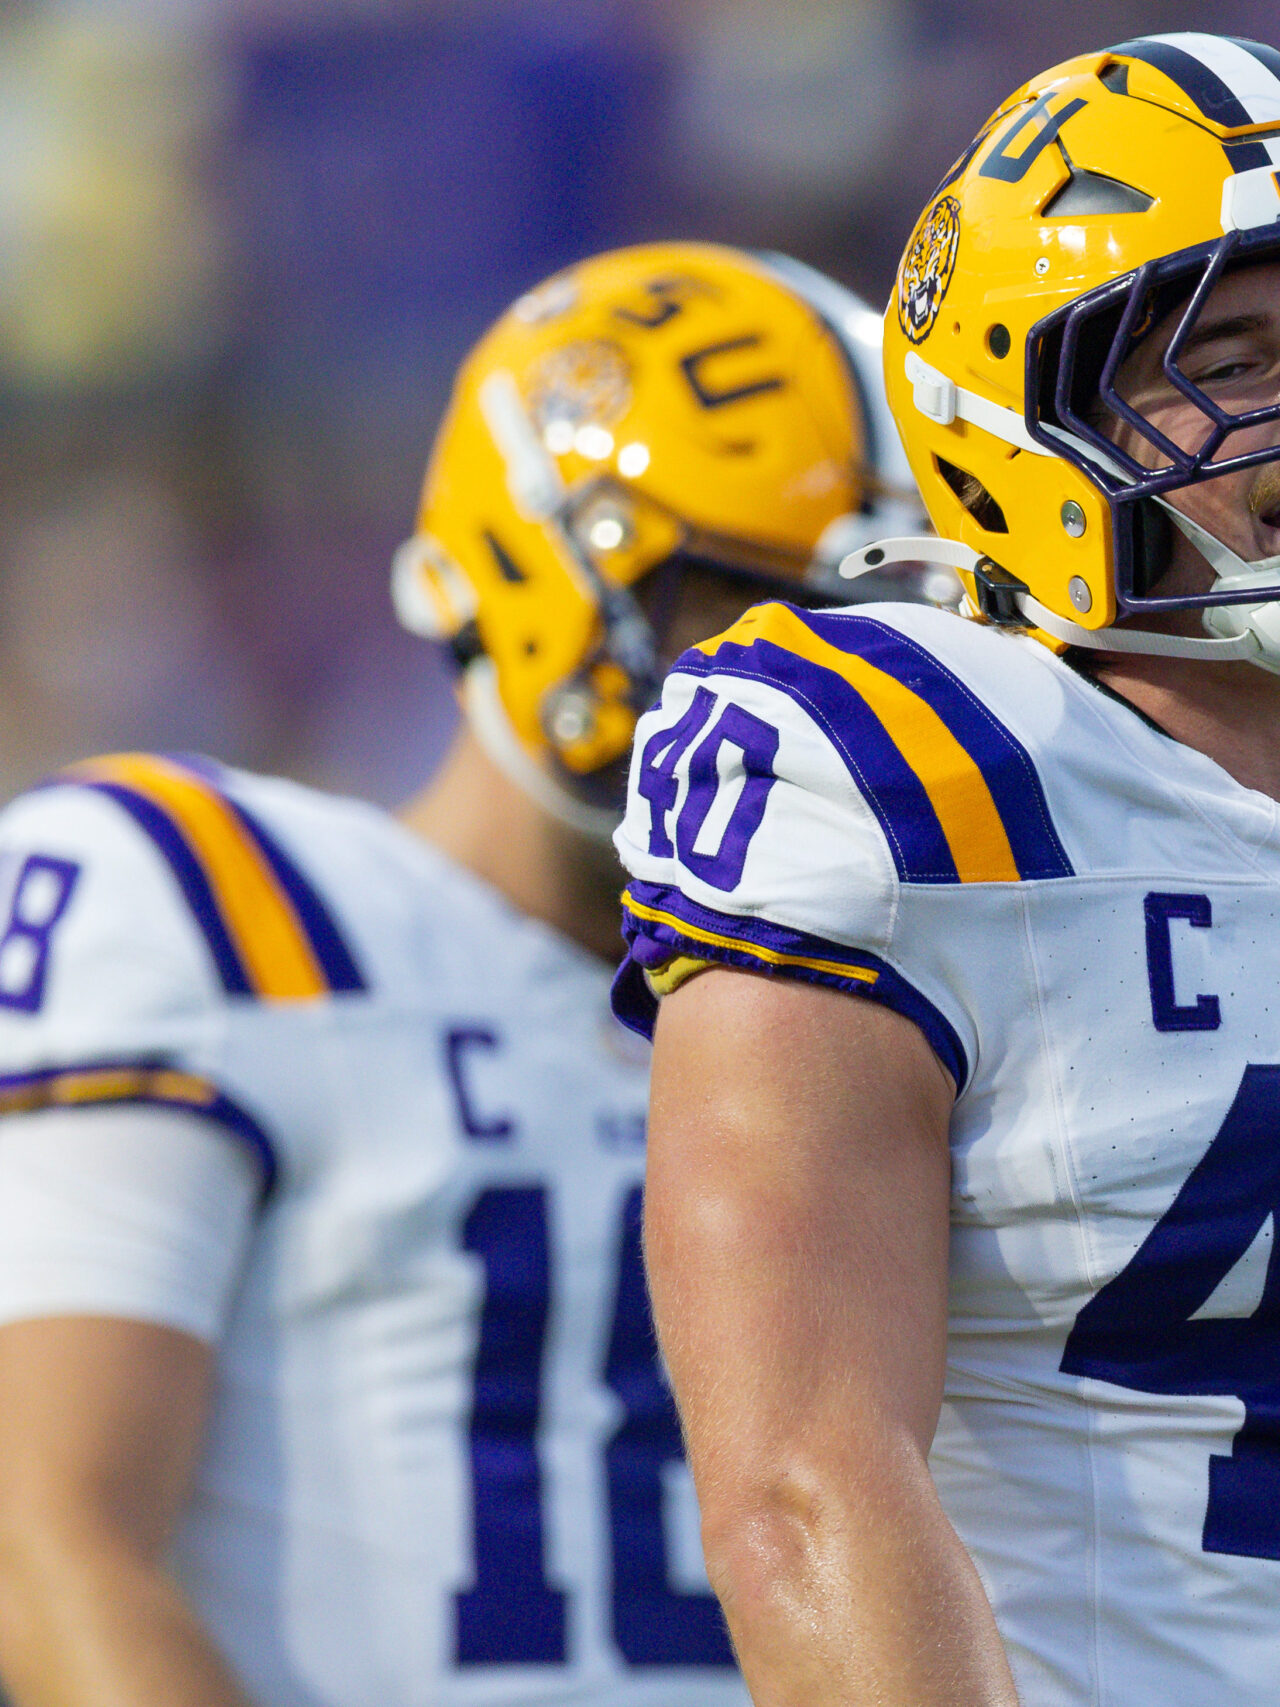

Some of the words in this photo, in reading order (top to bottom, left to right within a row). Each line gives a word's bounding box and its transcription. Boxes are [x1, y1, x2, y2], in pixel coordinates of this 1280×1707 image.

[638, 685, 780, 892] 40
[1144, 891, 1222, 1033] C
[445, 1026, 516, 1144] C
